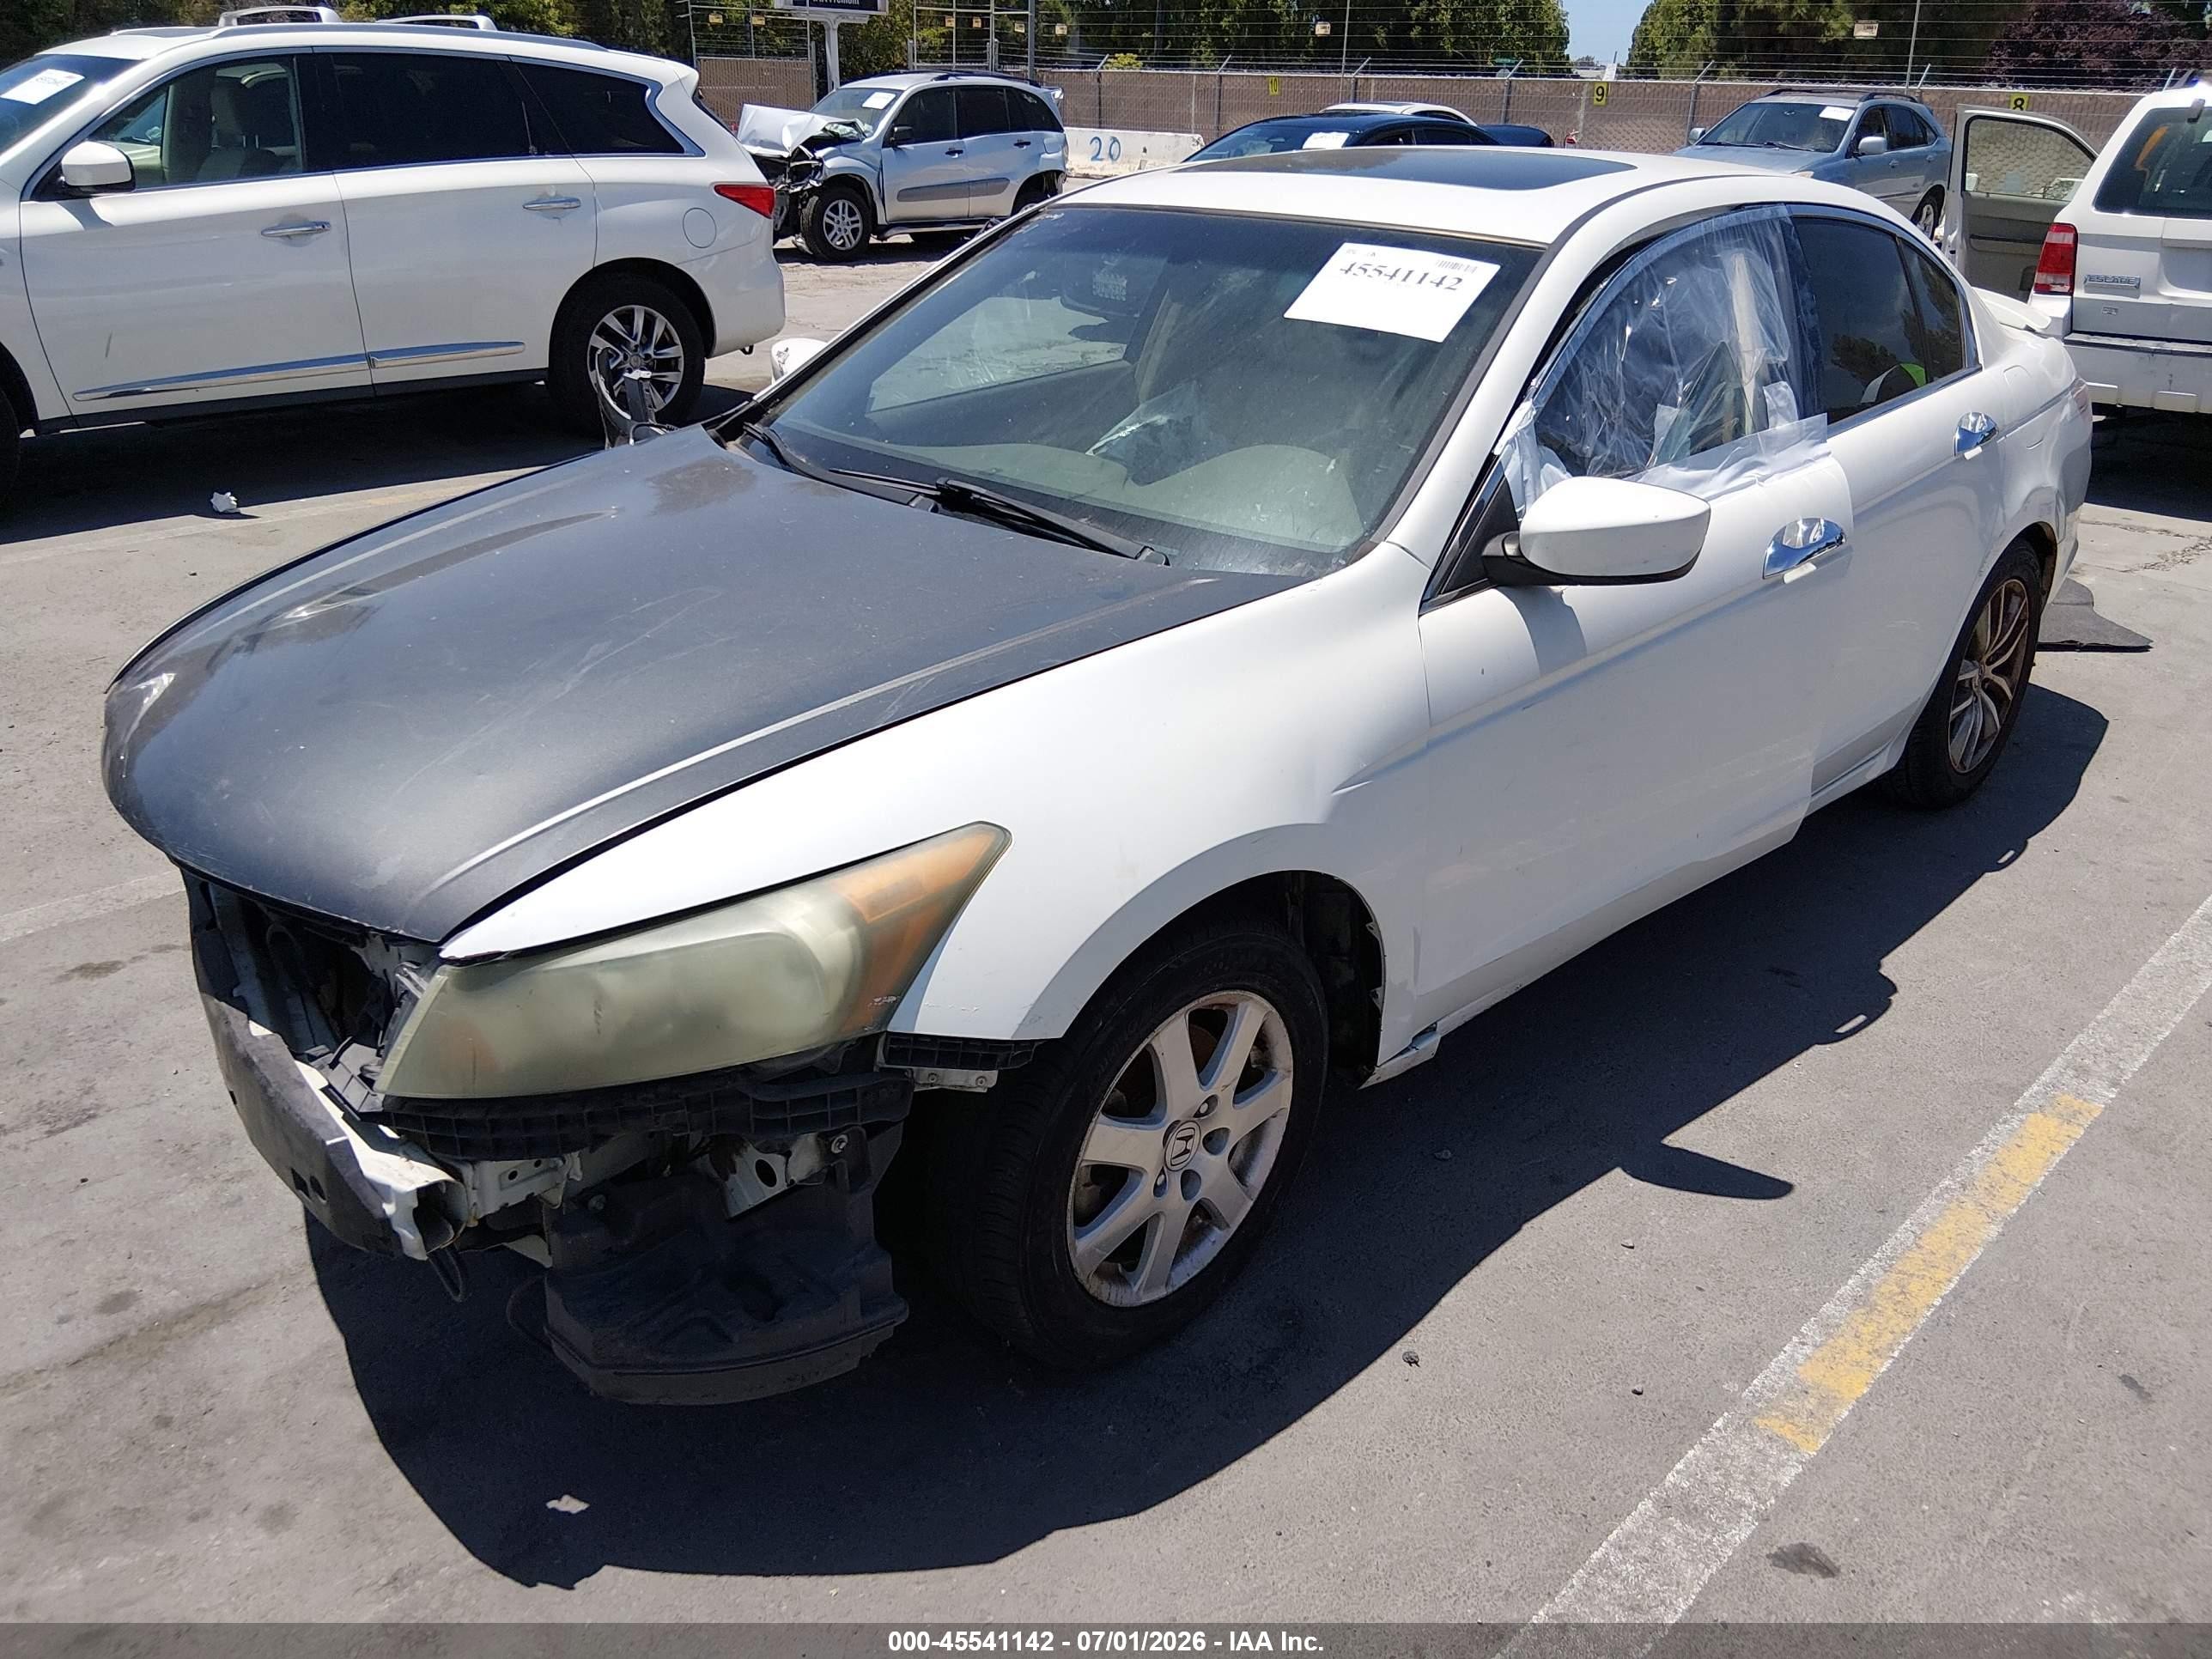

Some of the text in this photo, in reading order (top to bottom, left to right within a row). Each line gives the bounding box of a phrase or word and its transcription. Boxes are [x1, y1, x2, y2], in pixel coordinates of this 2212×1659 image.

[1271, 77, 1278, 93] 10
[1596, 86, 1604, 101] 9
[2013, 98, 2025, 111] 8
[1089, 136, 1121, 161] 20
[1340, 262, 1463, 291] 45541142
[2087, 275, 2136, 285] ESCAPE
